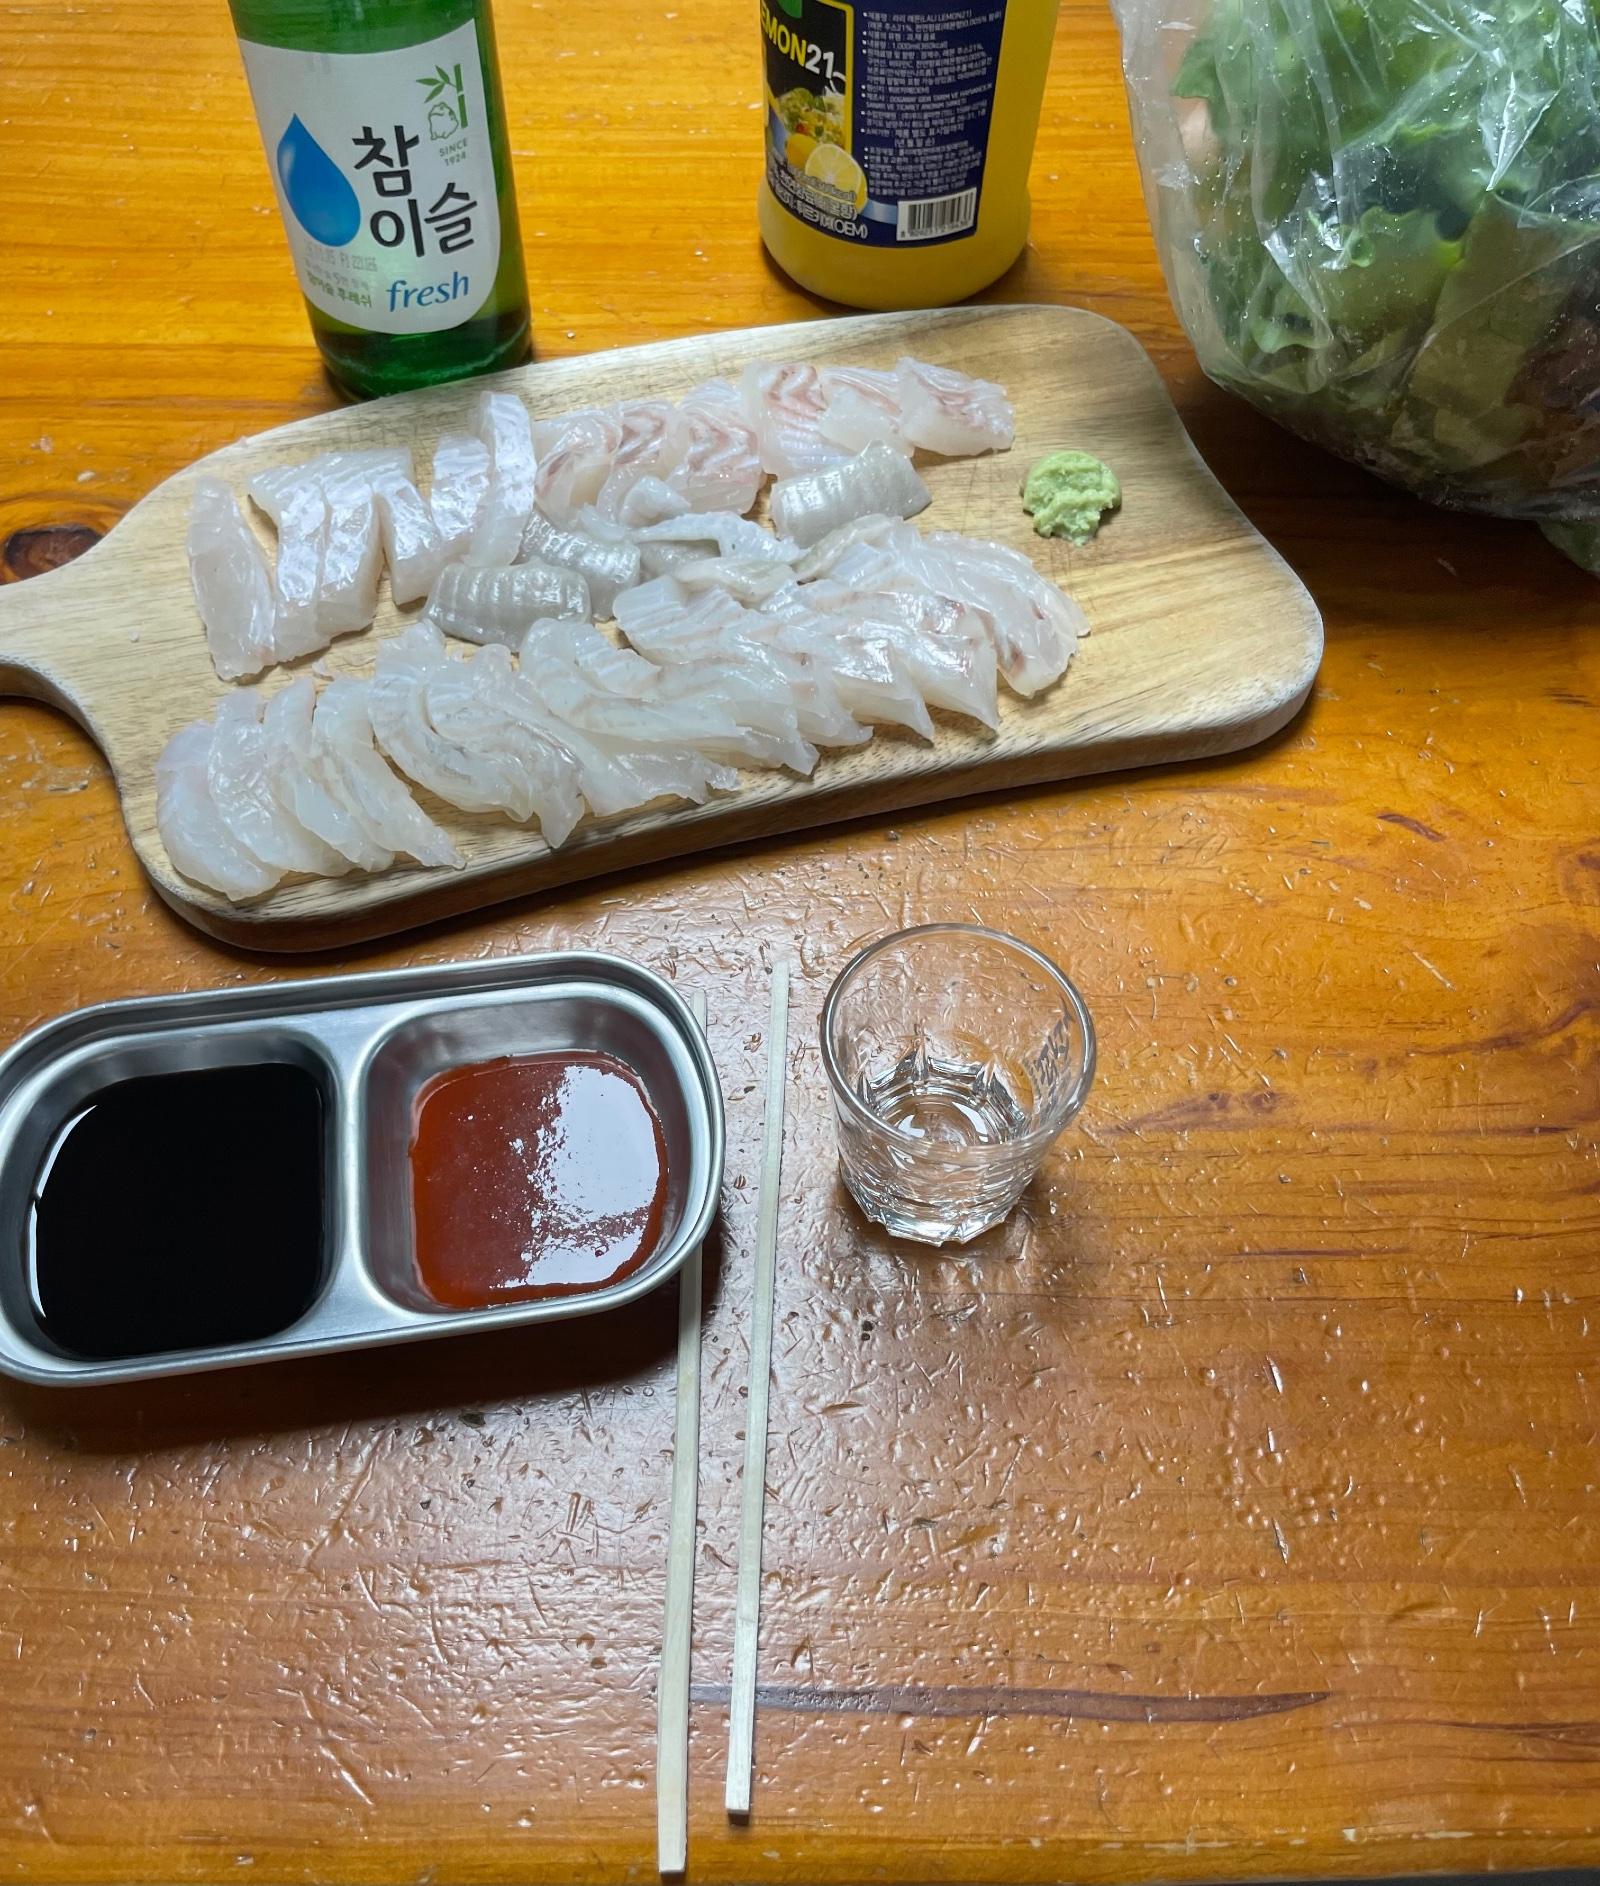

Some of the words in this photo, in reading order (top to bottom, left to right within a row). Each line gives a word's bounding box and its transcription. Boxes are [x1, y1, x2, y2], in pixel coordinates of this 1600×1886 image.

[352, 125, 420, 197] 참
[439, 138, 468, 157] SINCE
[370, 182, 478, 258] 이슬
[386, 271, 469, 312] fresh
